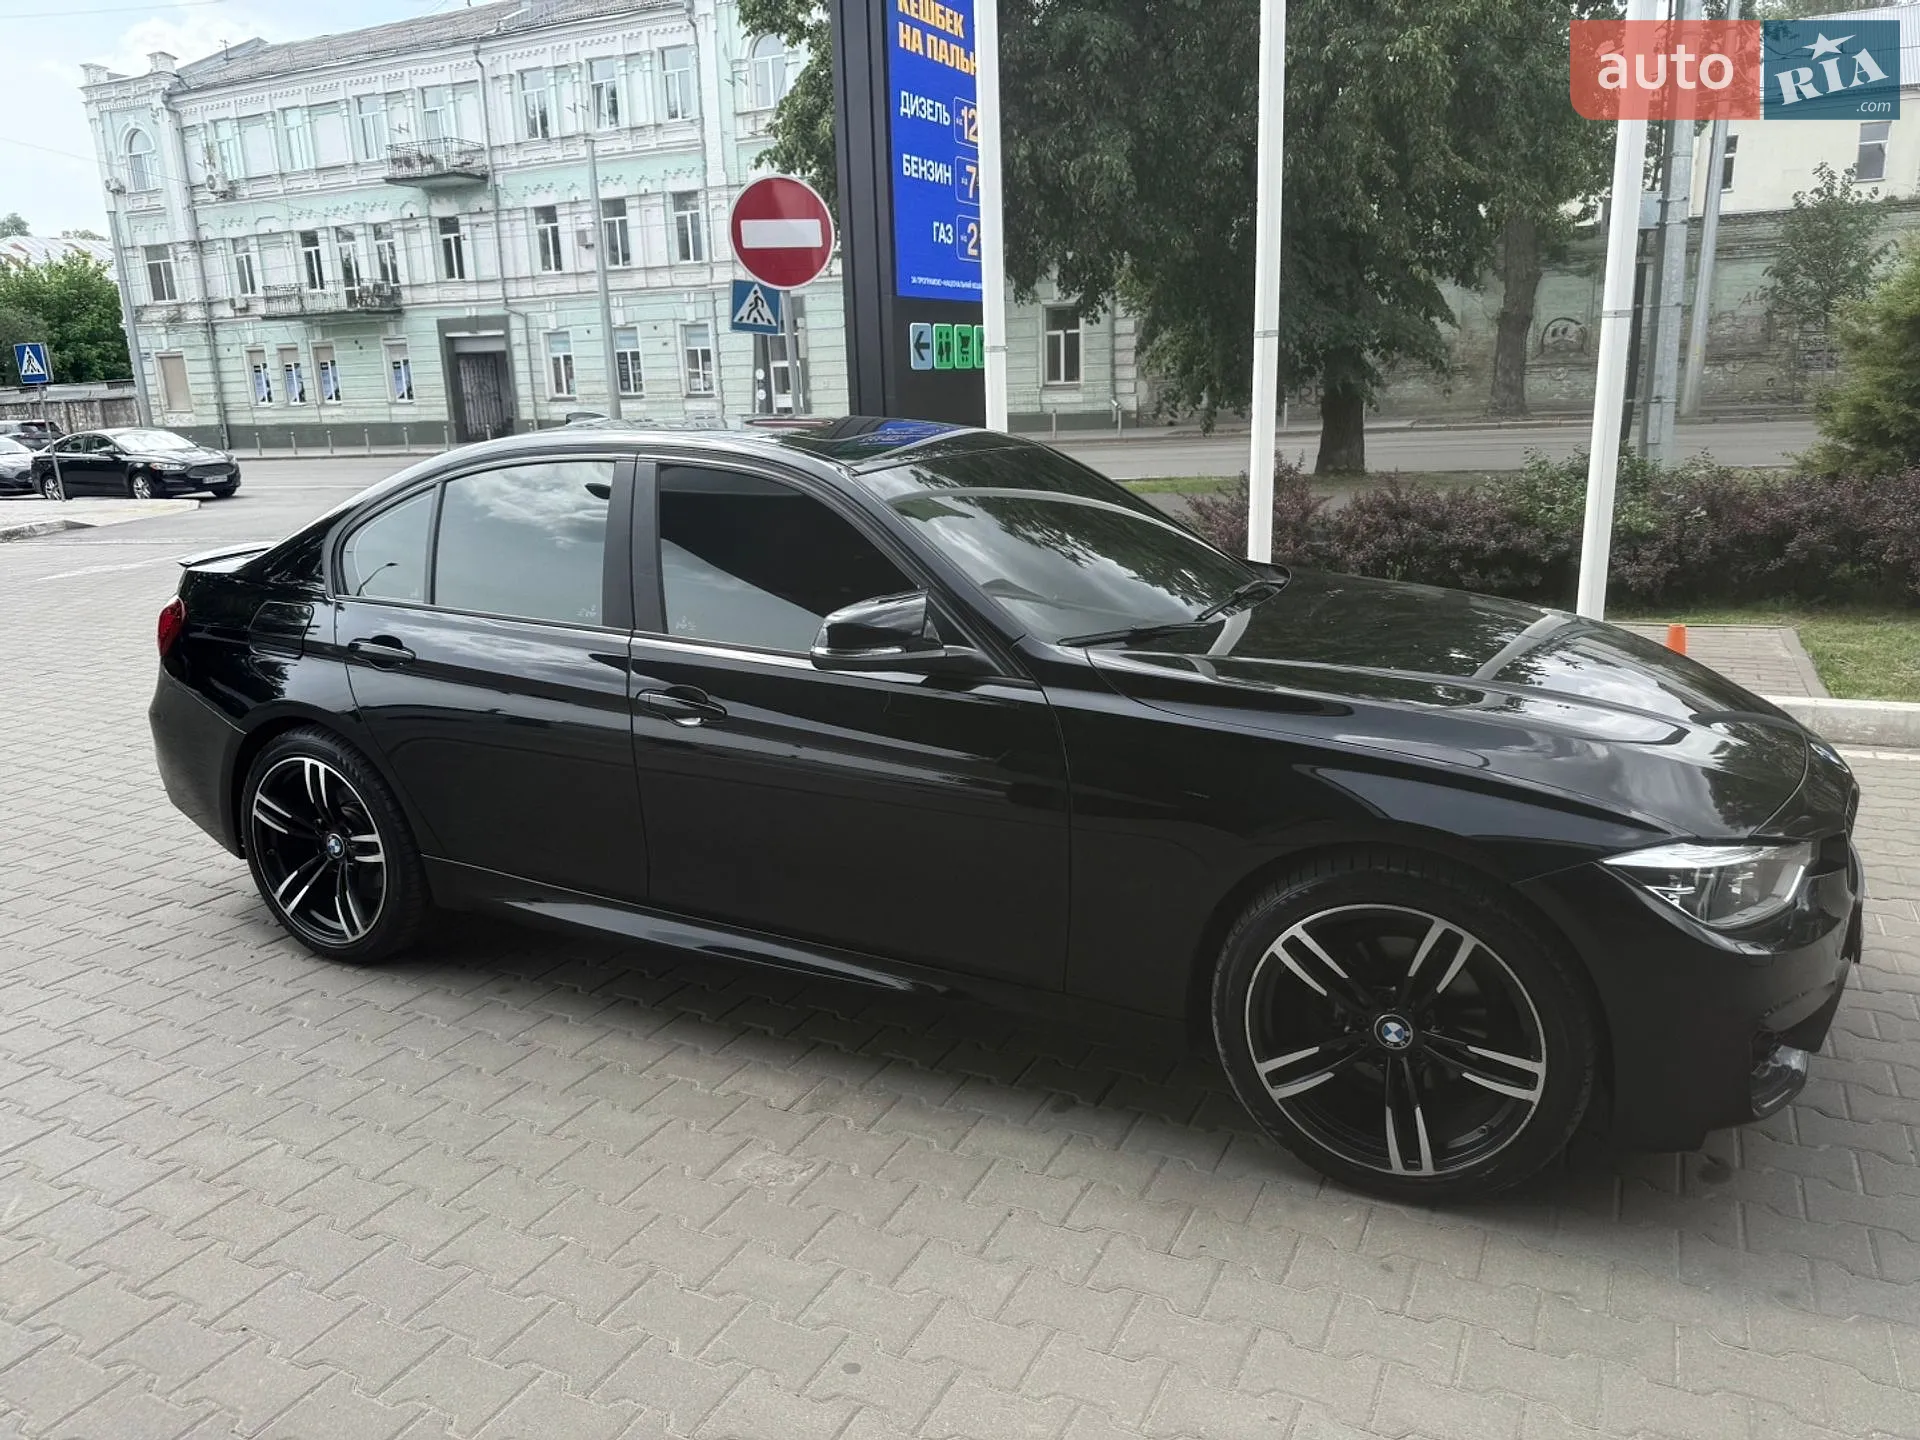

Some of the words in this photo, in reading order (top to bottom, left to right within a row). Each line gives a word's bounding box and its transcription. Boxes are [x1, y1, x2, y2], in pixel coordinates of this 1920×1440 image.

[898, 21, 924, 55] НА
[900, 90, 950, 126] ДИЗЕЛЬ
[902, 153, 952, 186] БЕНЗИН
[933, 221, 953, 245] ГАЗ
